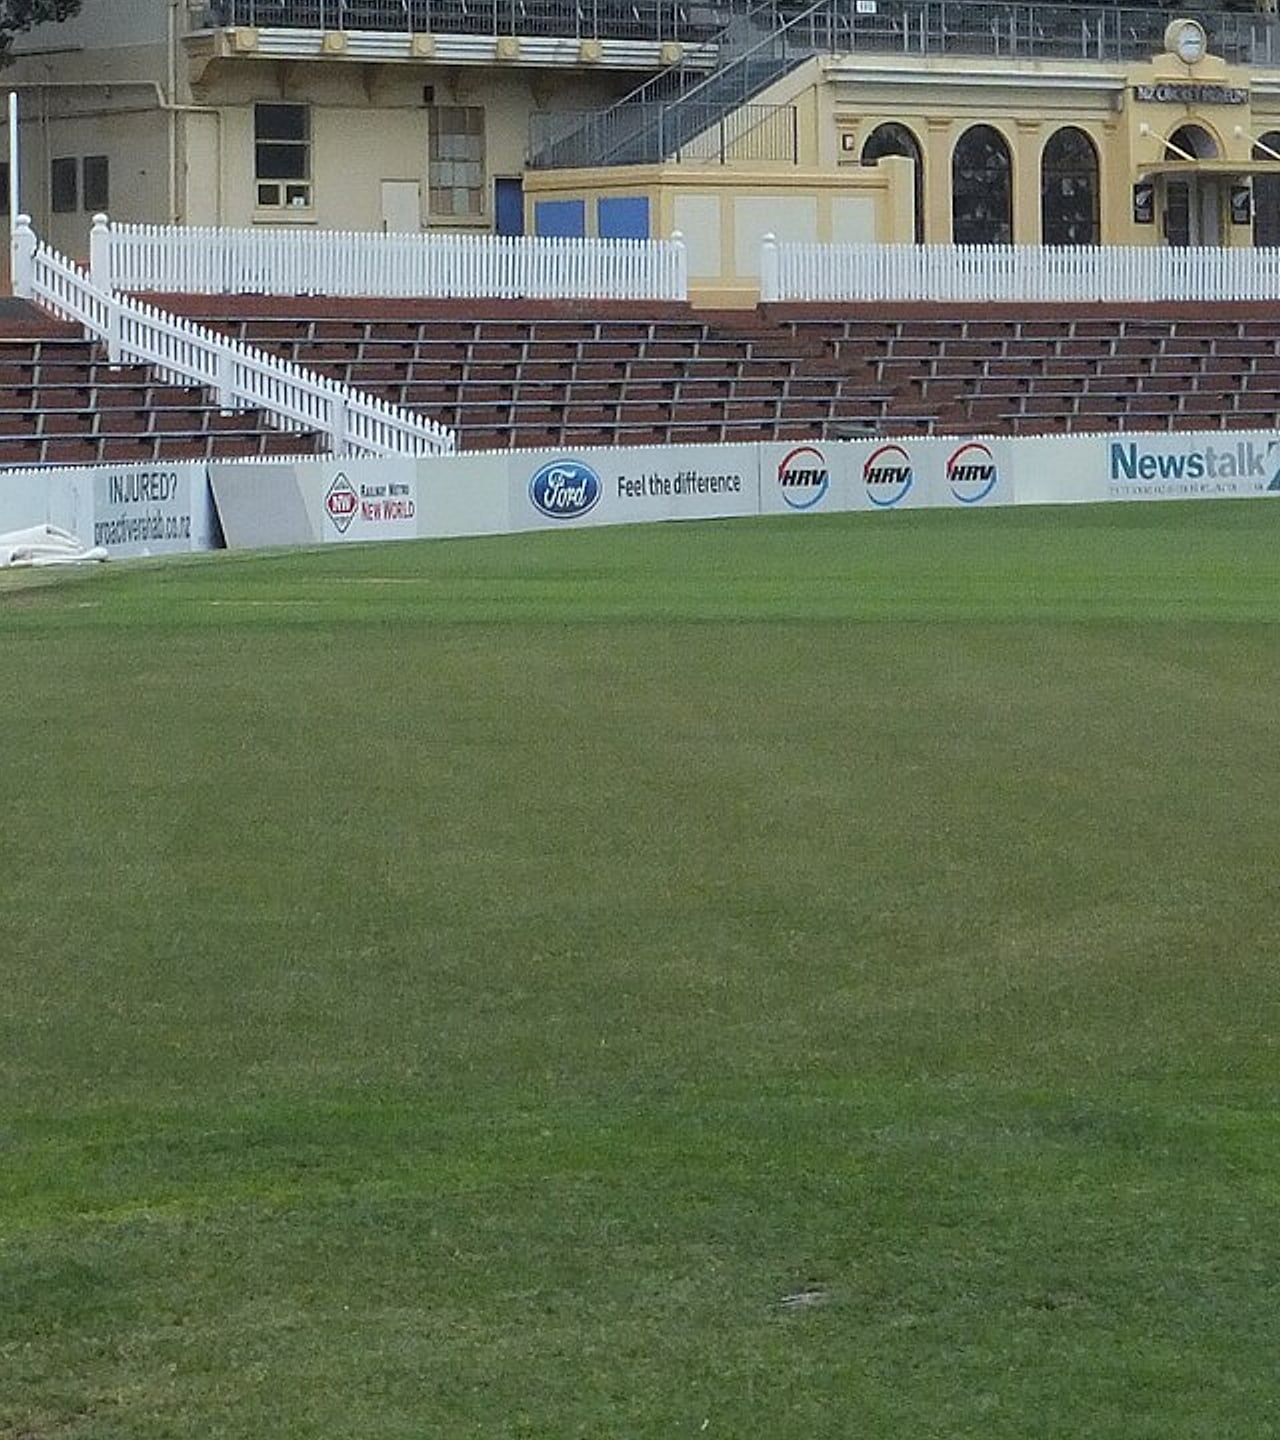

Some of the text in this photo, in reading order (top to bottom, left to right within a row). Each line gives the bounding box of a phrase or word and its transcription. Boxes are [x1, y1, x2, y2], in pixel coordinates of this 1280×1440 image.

[950, 465, 996, 482] HRV
[1111, 442, 1265, 480] Newstalk
[110, 472, 178, 504] INJURED?
[543, 468, 588, 509] Ford
[618, 470, 741, 497] Feel the difference
[782, 470, 828, 487] HRV
[866, 467, 912, 484] HRV
